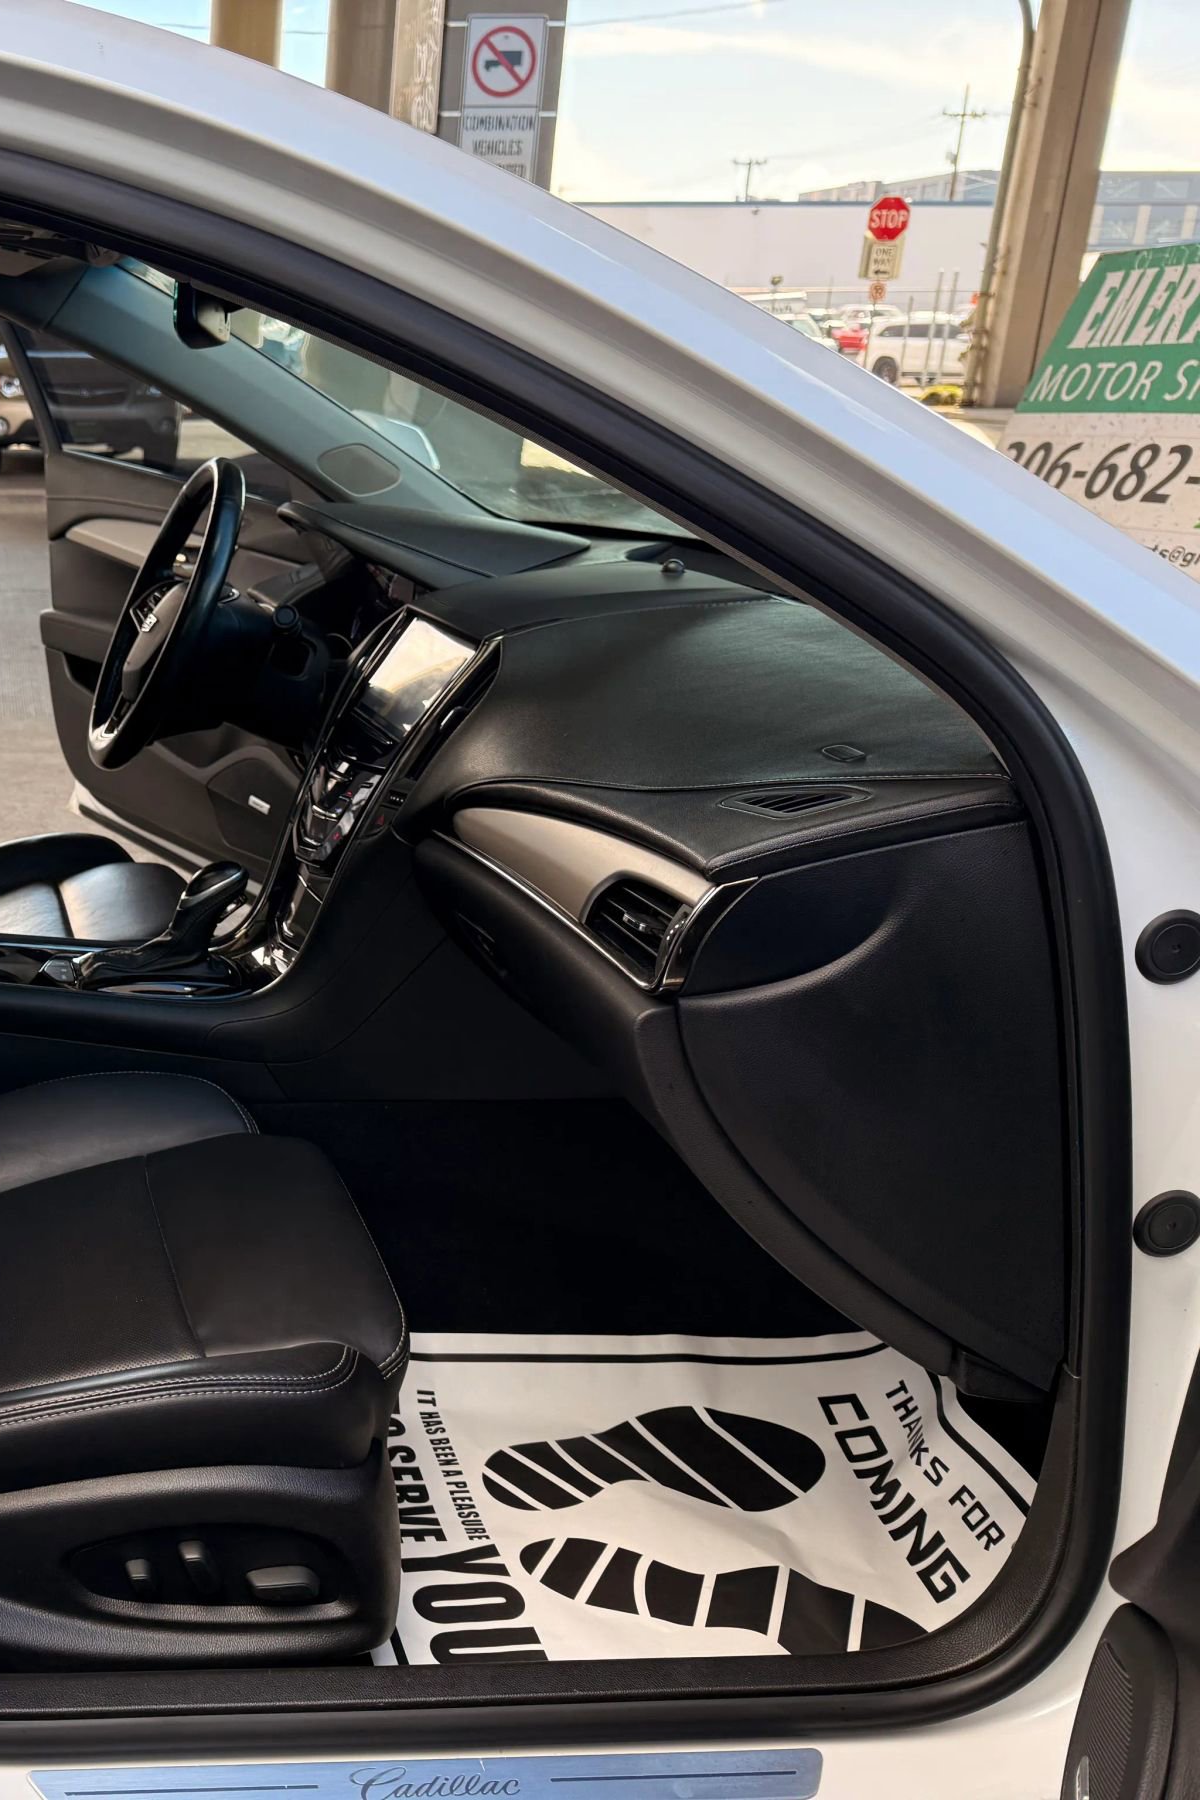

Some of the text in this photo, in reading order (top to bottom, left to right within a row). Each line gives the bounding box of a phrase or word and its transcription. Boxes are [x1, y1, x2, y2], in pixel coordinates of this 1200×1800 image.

[464, 115, 535, 131] COMBINATION
[473, 139, 522, 155] VEHICLES
[870, 208, 908, 228] STOP
[873, 257, 892, 266] WAY
[876, 247, 894, 257] ONE
[1029, 360, 1163, 402] MOTOR
[417, 1390, 491, 1541] IT HAS BEEN A PLEASURE
[885, 1380, 1006, 1551] THANKS FOR
[817, 1393, 971, 1604] COMING
[388, 1445, 549, 1664] SERVE YOU
[349, 1766, 521, 1800] Cadillac
